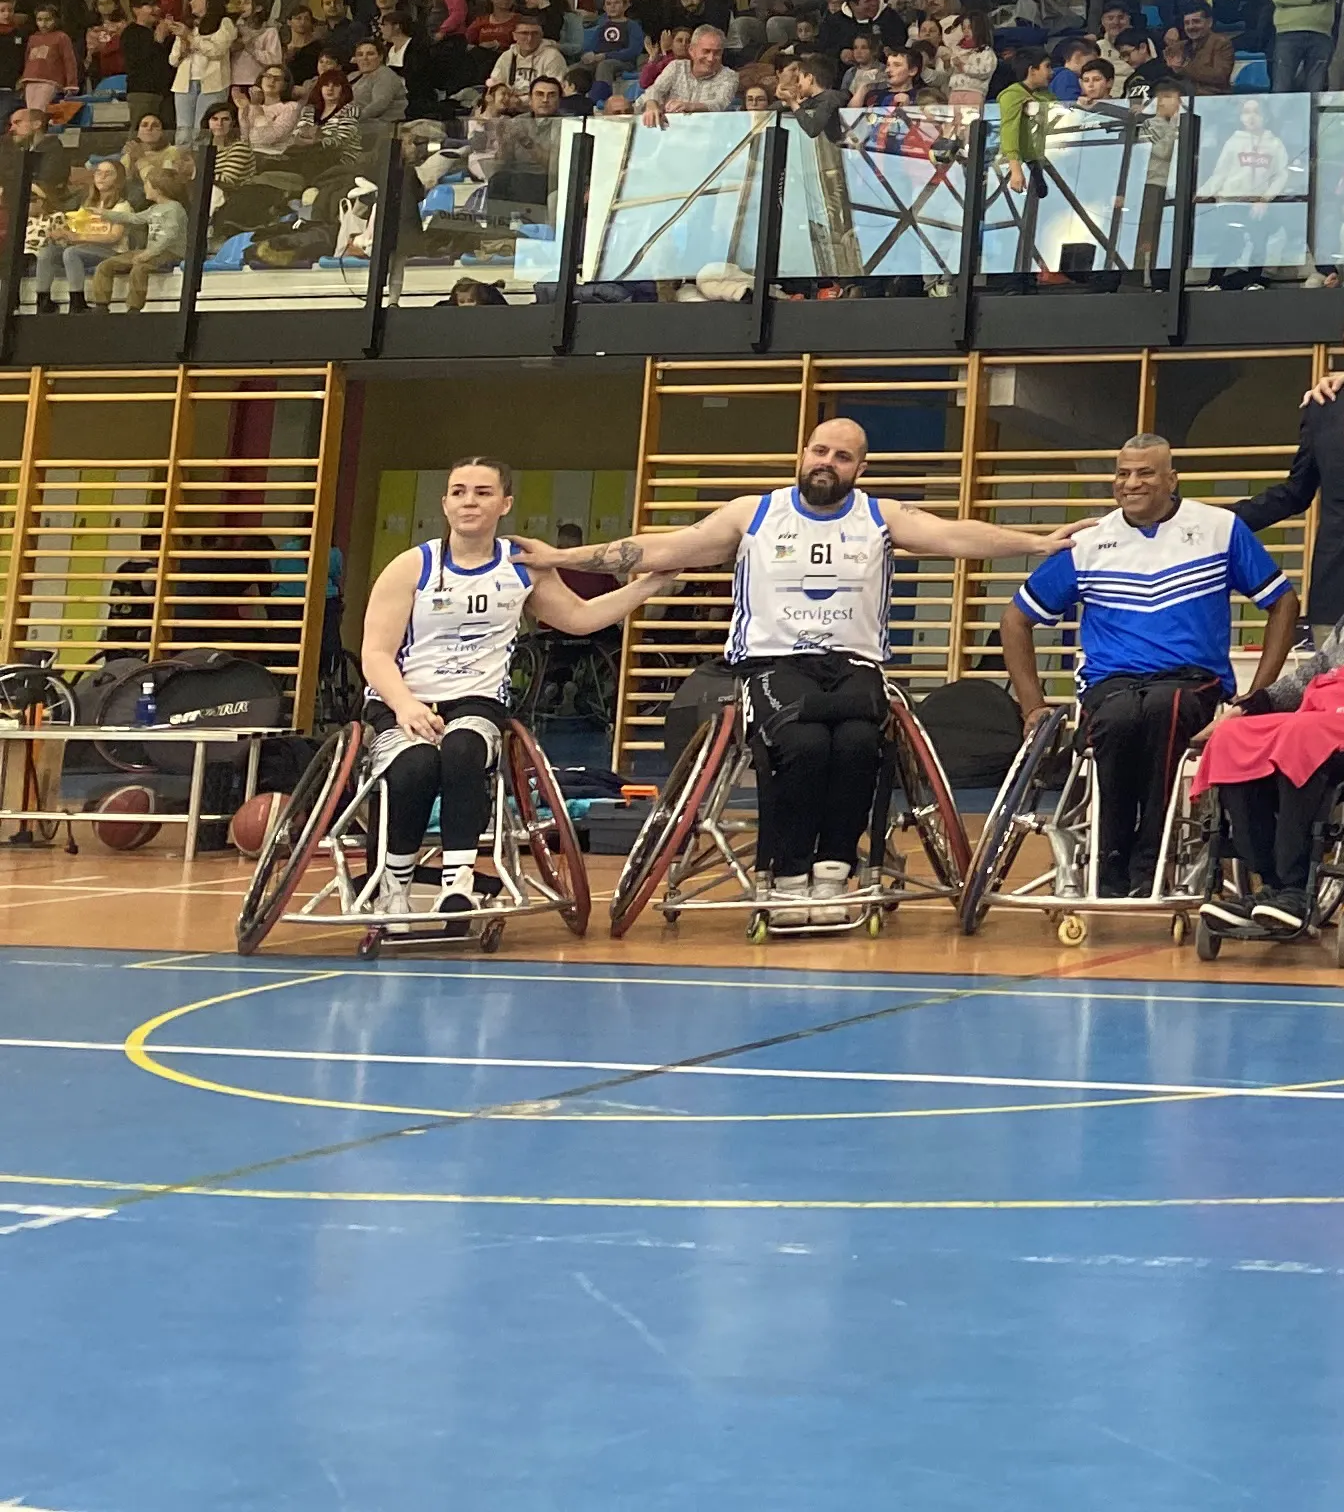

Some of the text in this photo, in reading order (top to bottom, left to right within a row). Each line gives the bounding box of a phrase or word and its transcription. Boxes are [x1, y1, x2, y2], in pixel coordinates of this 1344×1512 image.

[810, 543, 832, 564] 61
[466, 594, 488, 614] 10
[783, 606, 853, 625] Servigest
